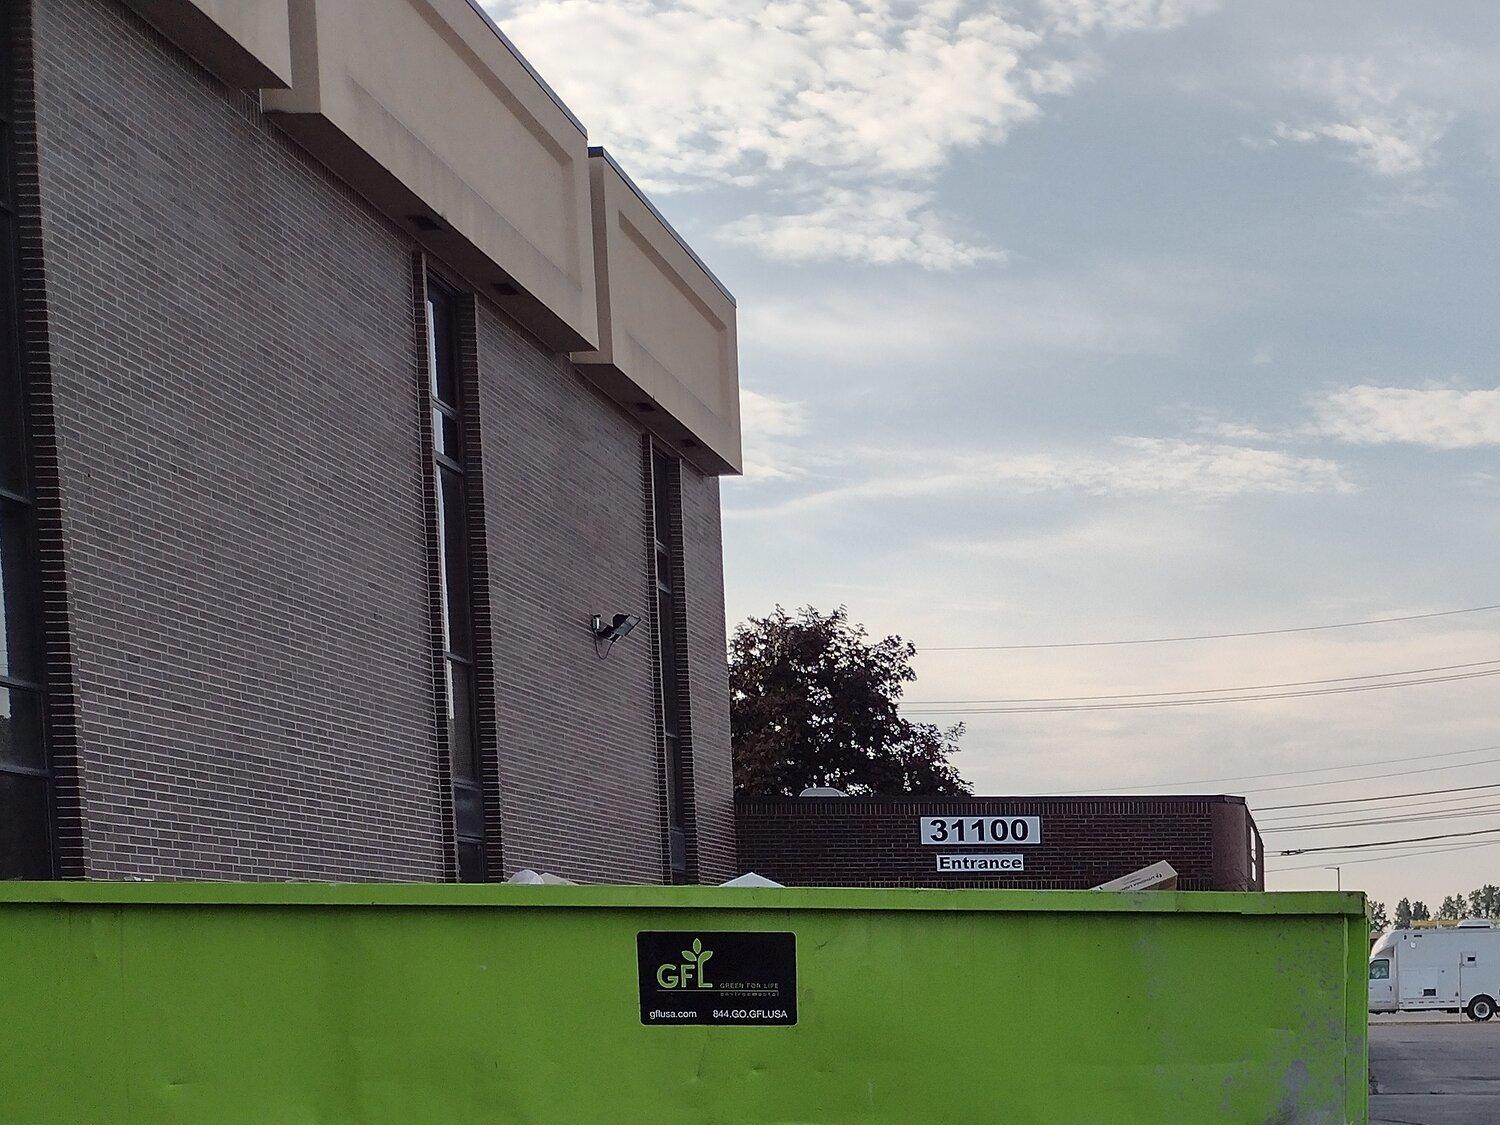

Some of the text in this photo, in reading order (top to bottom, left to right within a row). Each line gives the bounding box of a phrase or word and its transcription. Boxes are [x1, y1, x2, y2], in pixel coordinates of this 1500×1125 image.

[930, 819, 1029, 842] 31100
[939, 857, 1022, 869] Entrance
[656, 950, 714, 988] GFL
[649, 1009, 788, 1020] gflusa.com 844.GO.GFLUSA
